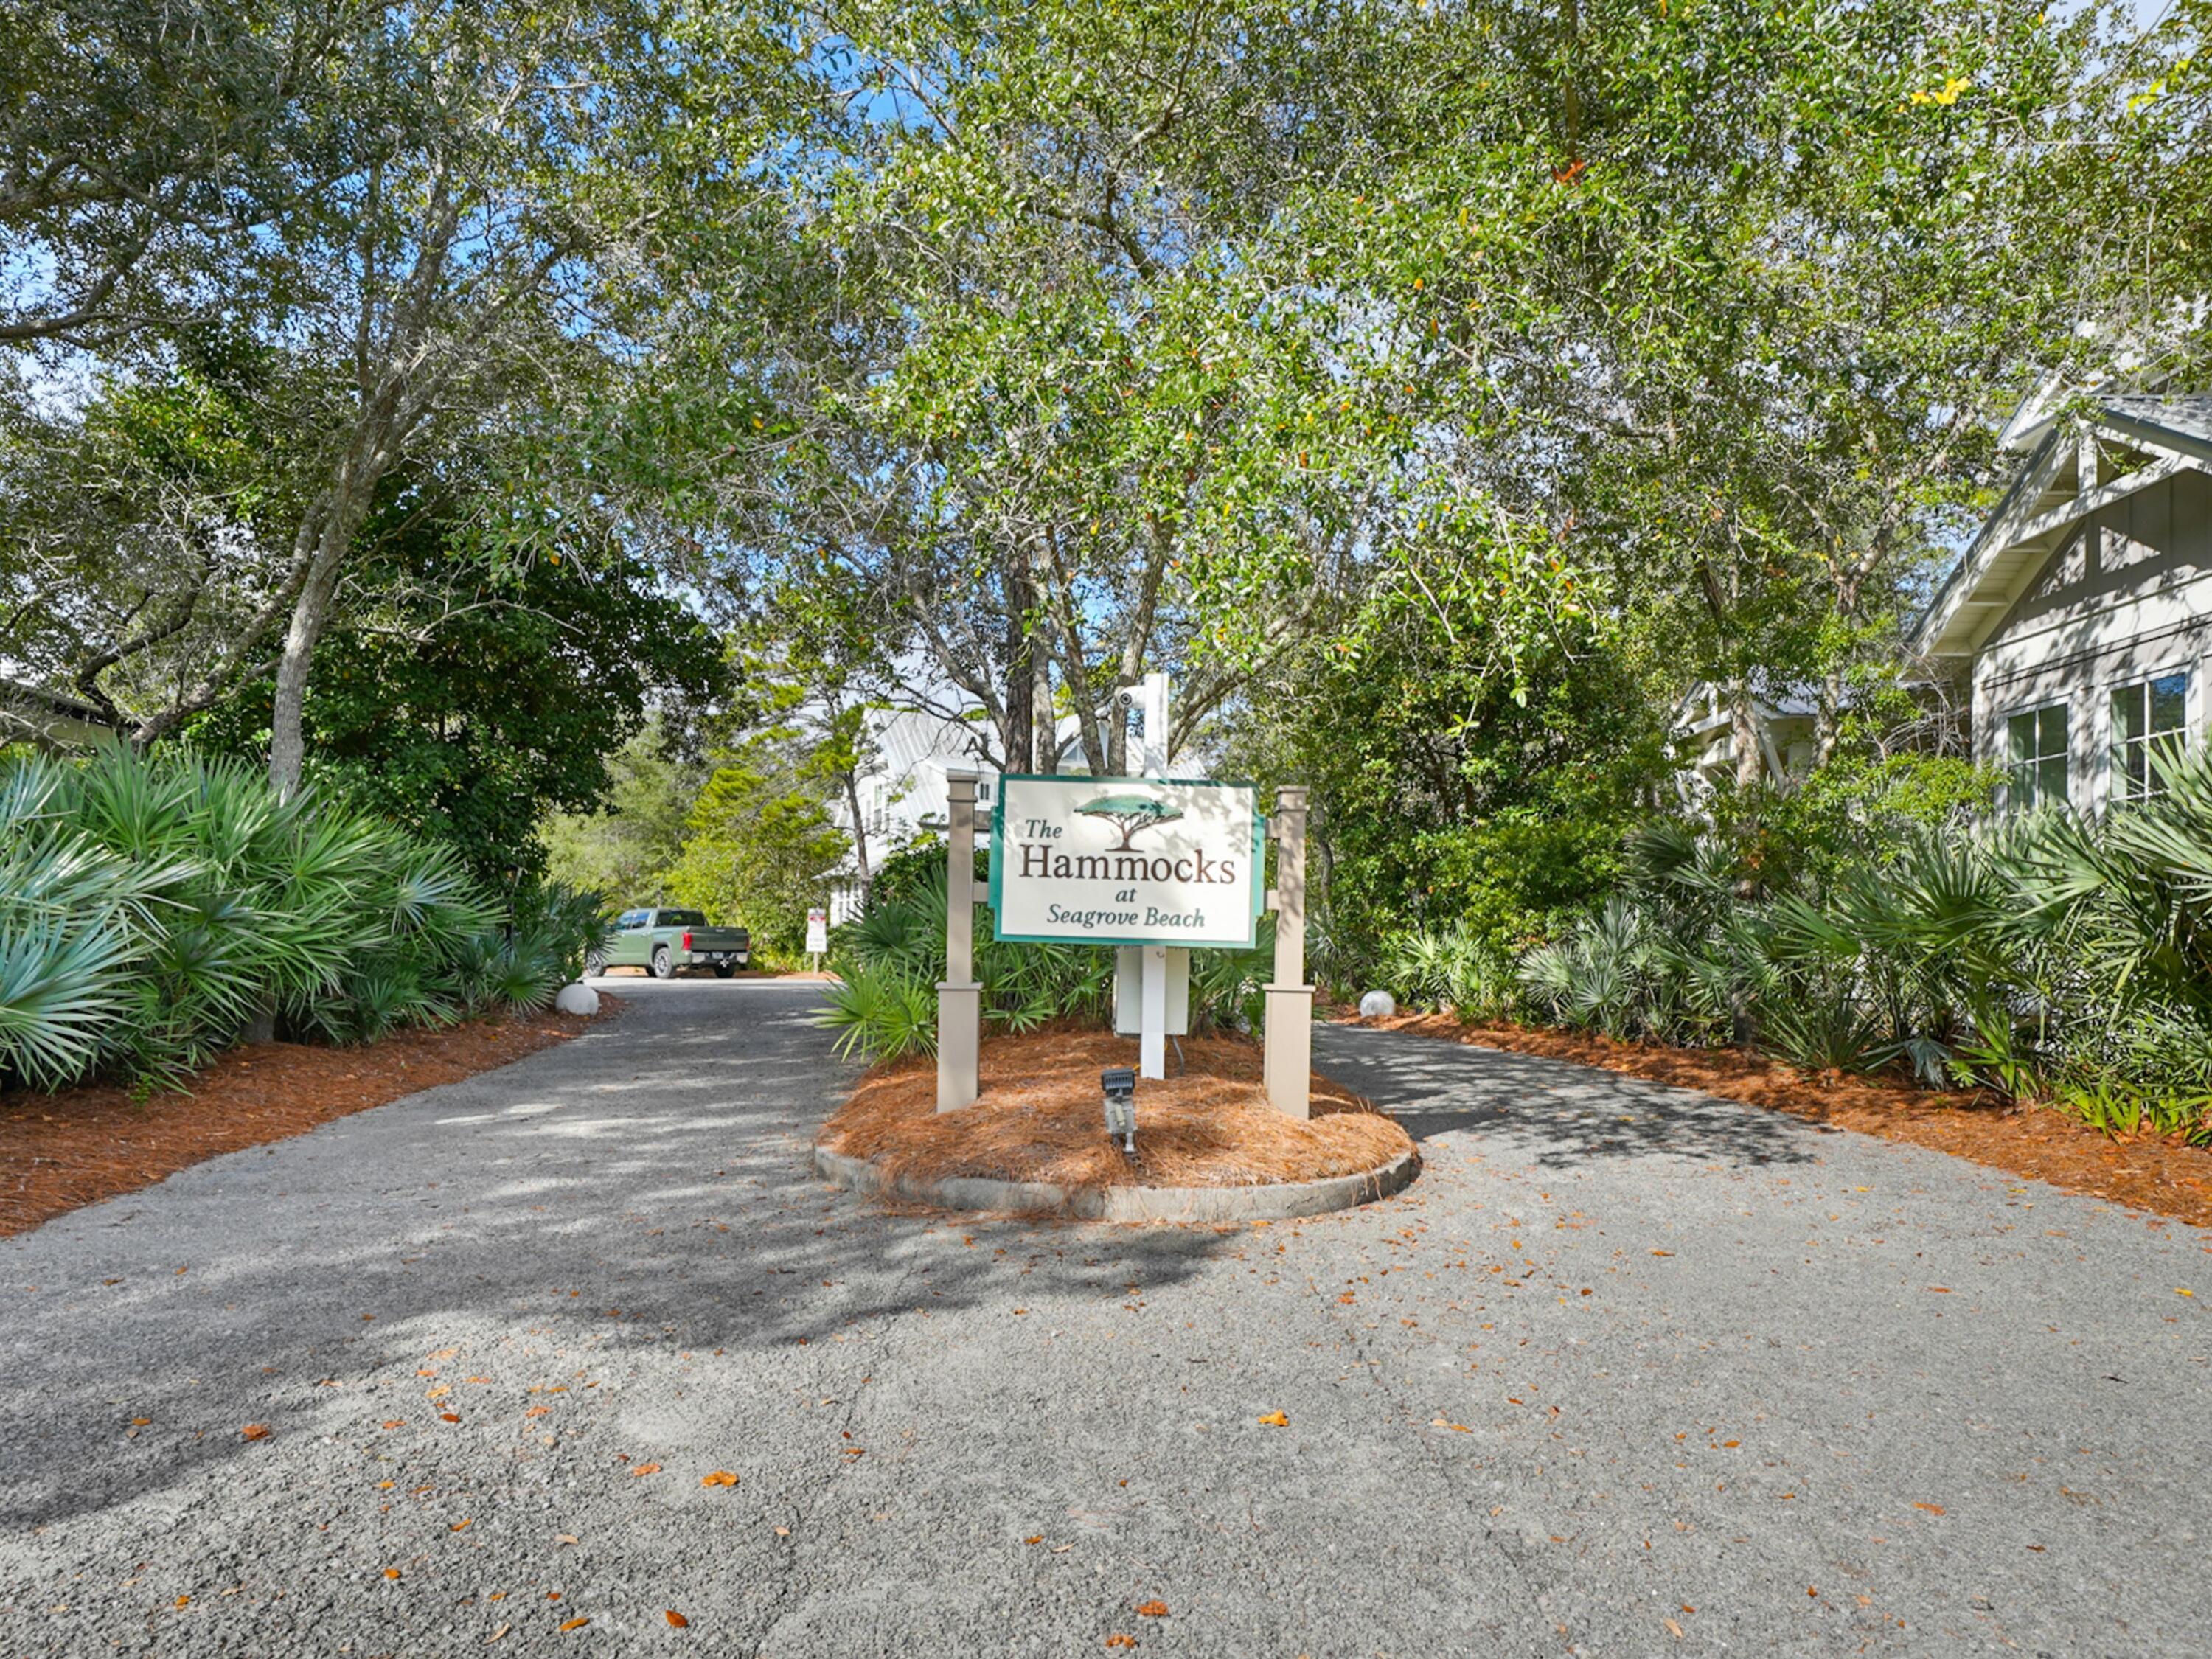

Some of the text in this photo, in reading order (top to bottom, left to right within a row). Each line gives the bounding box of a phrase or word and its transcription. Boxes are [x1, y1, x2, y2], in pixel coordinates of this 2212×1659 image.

[1026, 819, 1062, 839] The
[1019, 844, 1236, 884] Hammocks
[1115, 888, 1137, 902] at
[1047, 904, 1205, 928] Seagrove Beach
